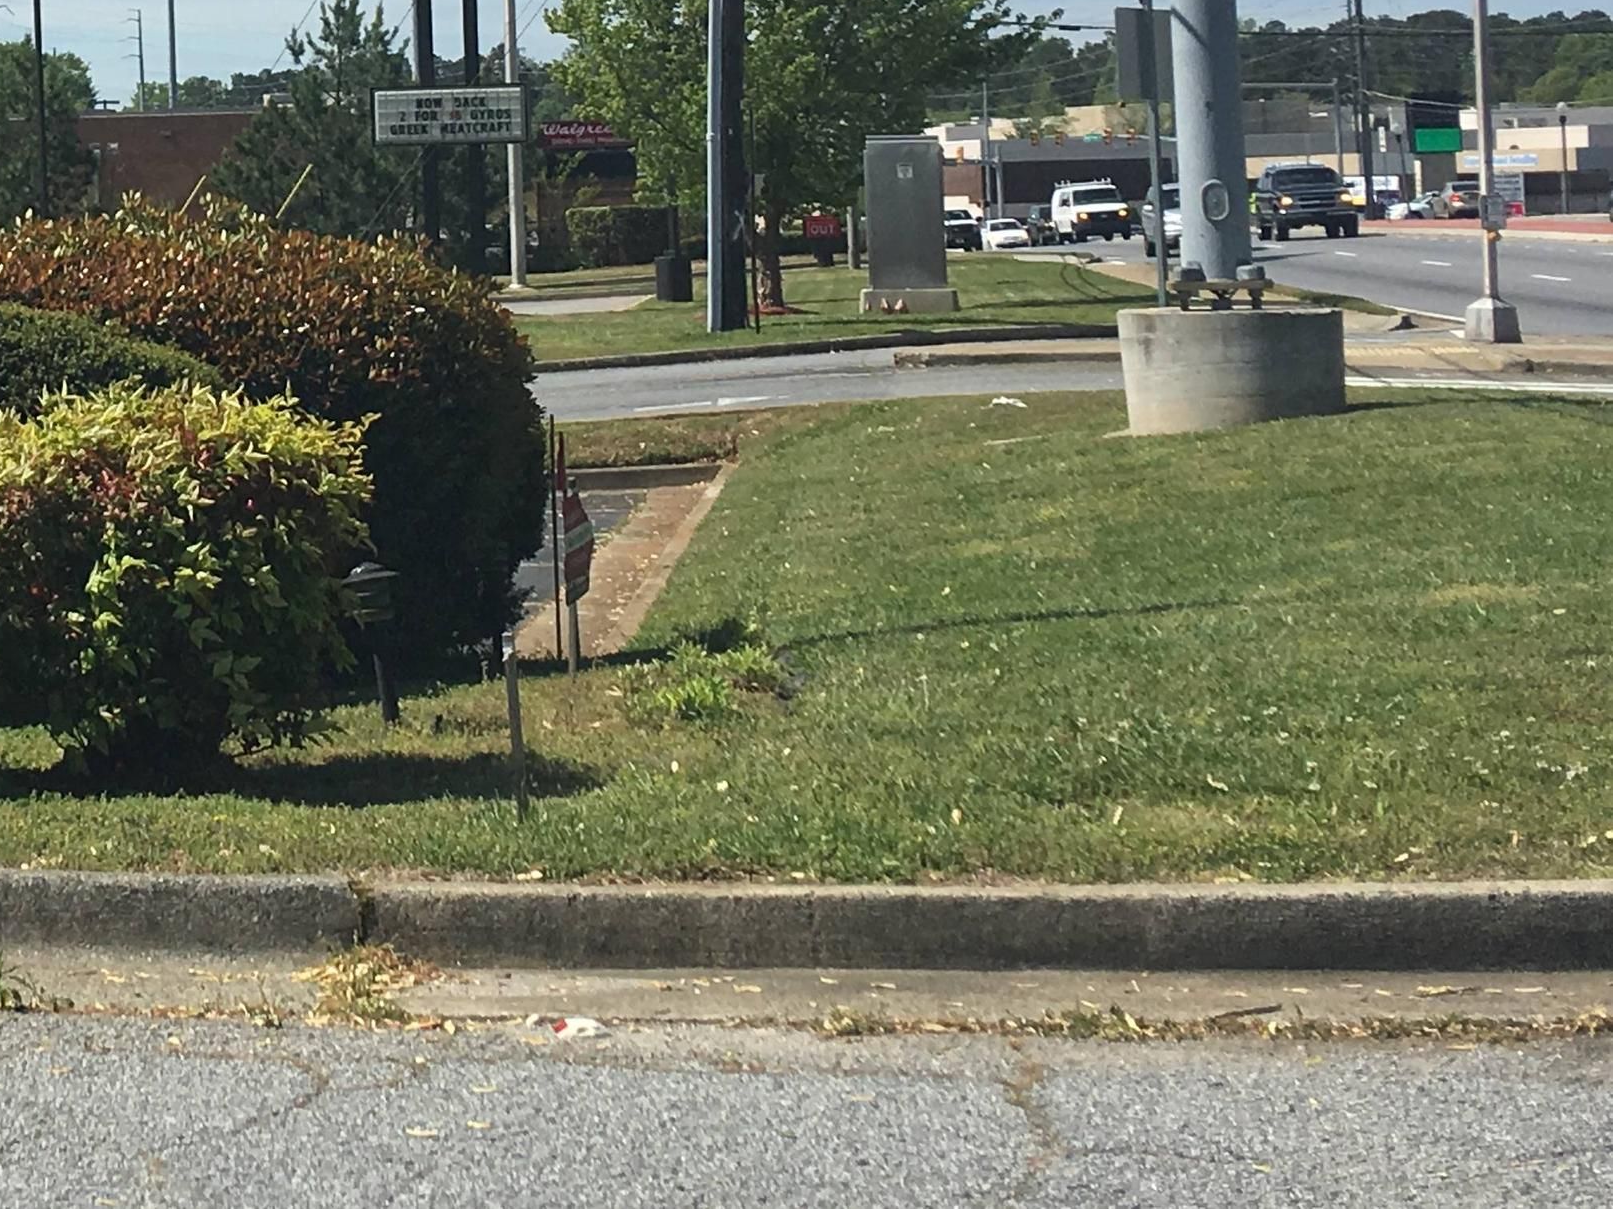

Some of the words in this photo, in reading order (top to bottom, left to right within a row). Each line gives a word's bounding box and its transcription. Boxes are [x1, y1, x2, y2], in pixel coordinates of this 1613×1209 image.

[399, 111, 407, 121] 2
[415, 110, 440, 121] FOR
[470, 108, 512, 120] GYROS
[810, 224, 835, 235] OUT
